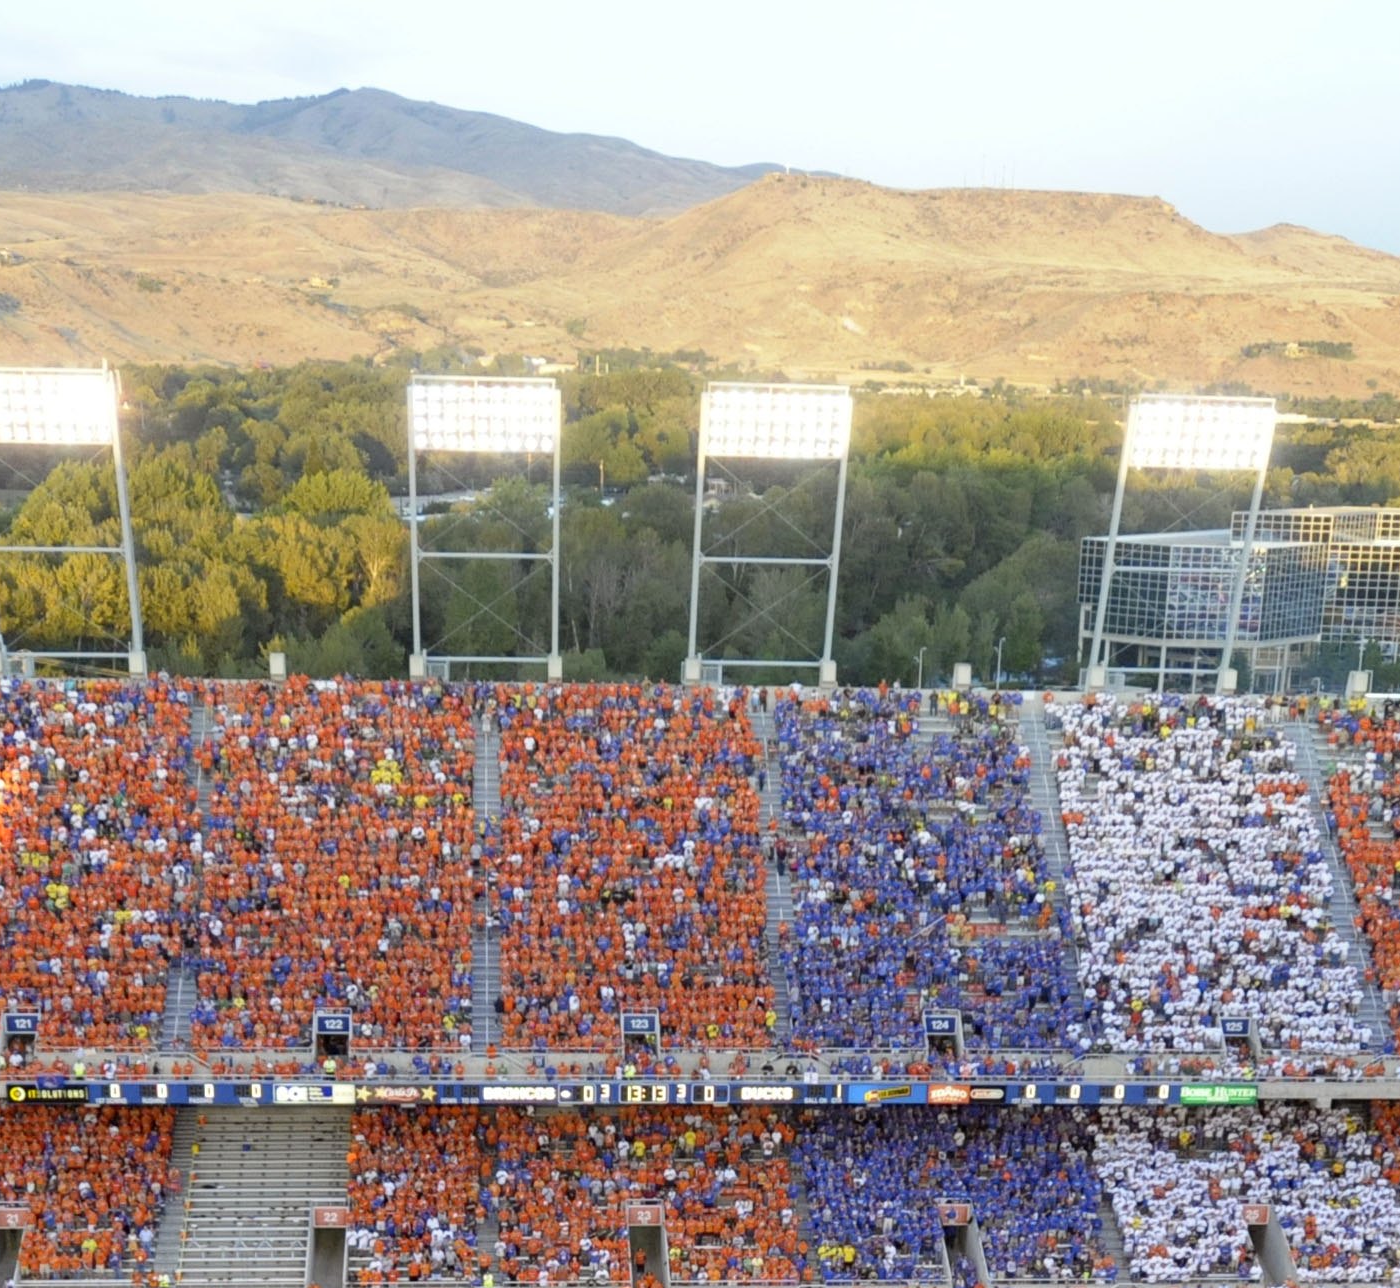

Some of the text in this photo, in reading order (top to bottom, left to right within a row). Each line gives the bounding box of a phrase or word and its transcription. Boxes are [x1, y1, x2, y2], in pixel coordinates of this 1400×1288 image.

[14, 1018, 31, 1029] 121
[324, 1019, 343, 1029] 122
[630, 1019, 648, 1029] 123
[932, 1020, 949, 1030] 124
[1226, 1022, 1242, 1032] 125
[483, 1087, 556, 1100] BRONCOS
[583, 1085, 593, 1101] 0
[600, 1084, 610, 1098] 3
[627, 1086, 667, 1101] 13:13
[676, 1084, 686, 1098] 3
[704, 1085, 714, 1101] 0
[741, 1087, 793, 1100] DUCKS
[6, 1212, 19, 1224] 21
[323, 1212, 338, 1223] 22
